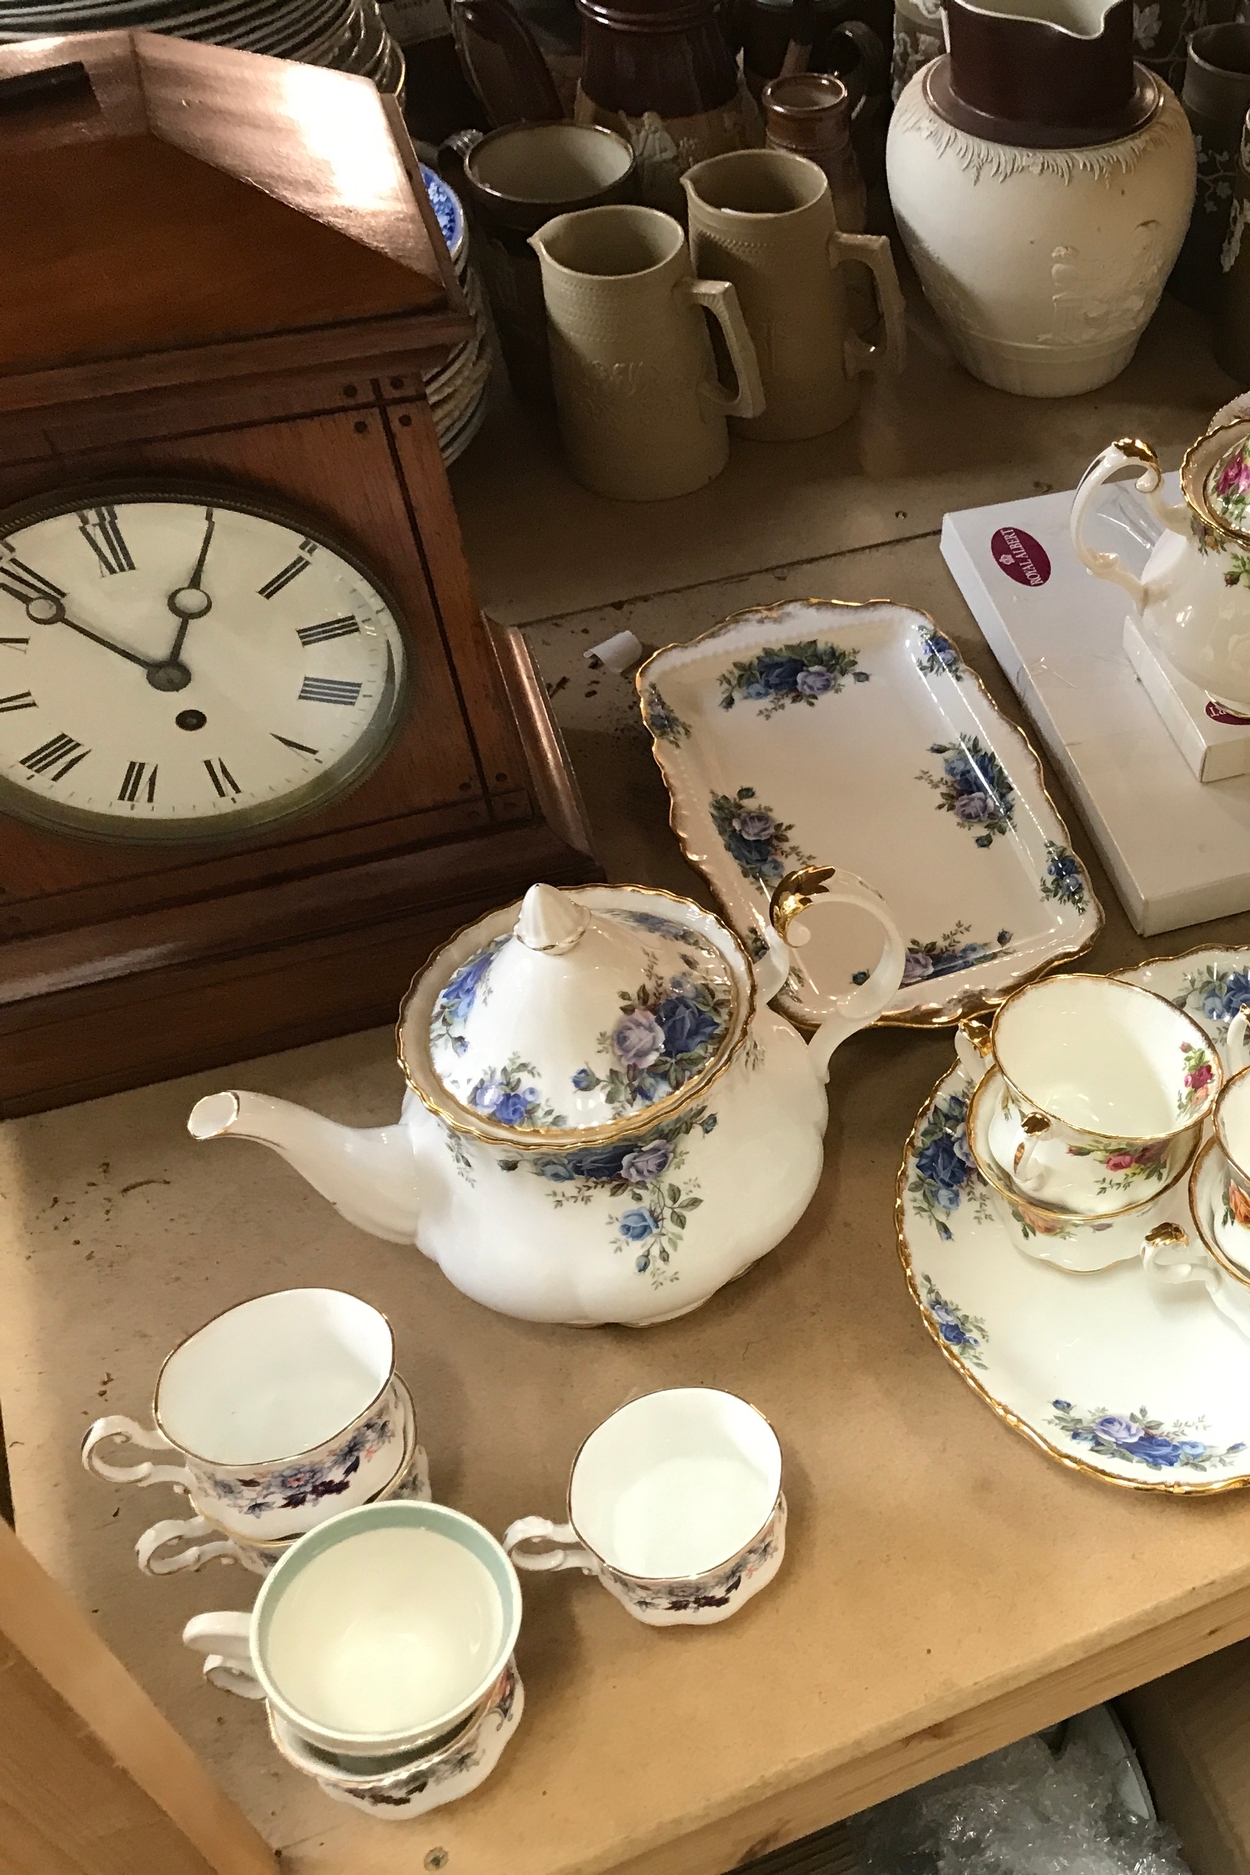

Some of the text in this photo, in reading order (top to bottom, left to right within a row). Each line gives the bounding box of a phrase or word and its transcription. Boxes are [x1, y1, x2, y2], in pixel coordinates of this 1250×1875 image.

[78, 521, 138, 578] XII
[1000, 529, 1044, 586] ROYAL ALBERT
[296, 614, 360, 648] III
